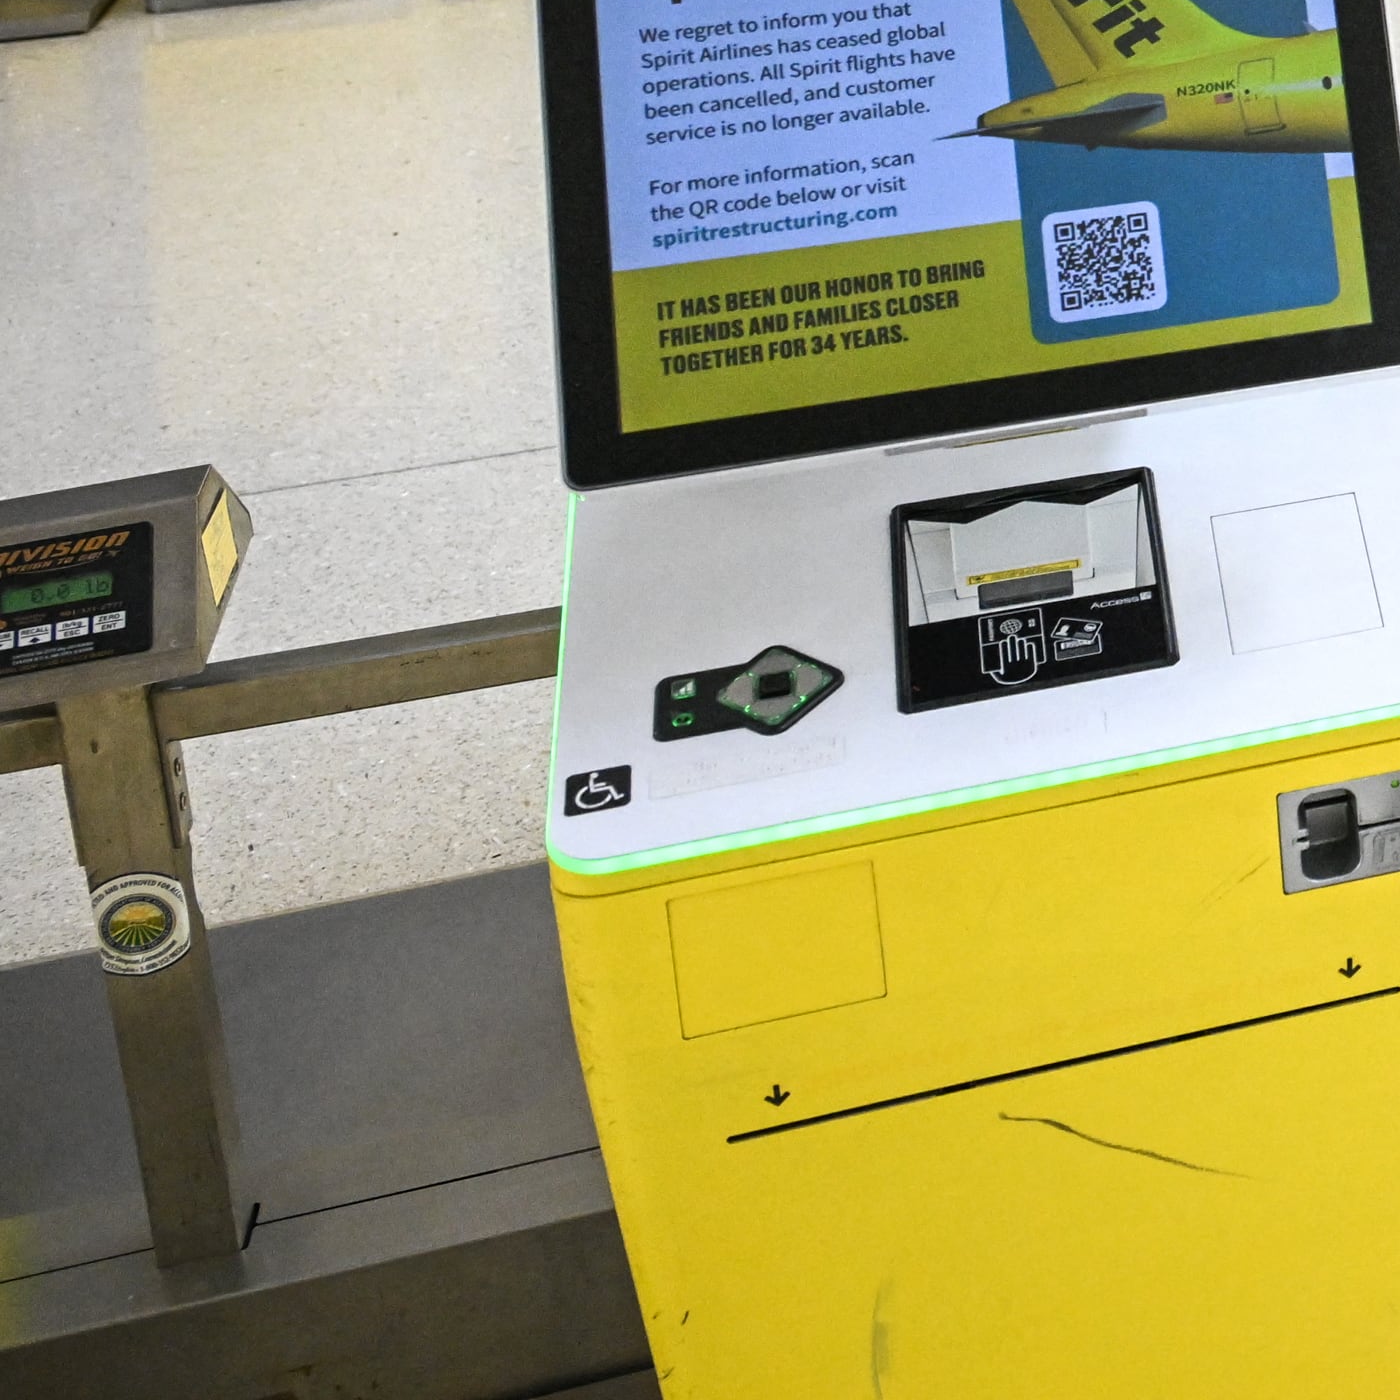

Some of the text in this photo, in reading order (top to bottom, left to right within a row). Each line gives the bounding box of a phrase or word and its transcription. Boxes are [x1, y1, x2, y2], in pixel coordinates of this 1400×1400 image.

[639, 1, 912, 44] We regret to inform you that
[641, 21, 945, 71] Spirit Airlines has ceased global
[642, 47, 956, 97] operations. All Spirit flights have
[1176, 79, 1236, 98] N320NK
[644, 75, 936, 120] been cancelled, and customer
[646, 99, 931, 146] service is no longer available.
[649, 153, 915, 196] For more information, scan
[651, 176, 907, 222] the QR code below or visit
[652, 204, 898, 249] spiritrestructuring.com
[657, 259, 985, 321] IT HAS BEEN OUR HONOR TO BRING
[659, 289, 960, 349] FRIENDS AND FAMILIES CLOSER
[661, 324, 909, 376] TOGETHER FOR 34 YEARS.
[20, 627, 48, 635] RECALL
[63, 629, 80, 637] ESC
